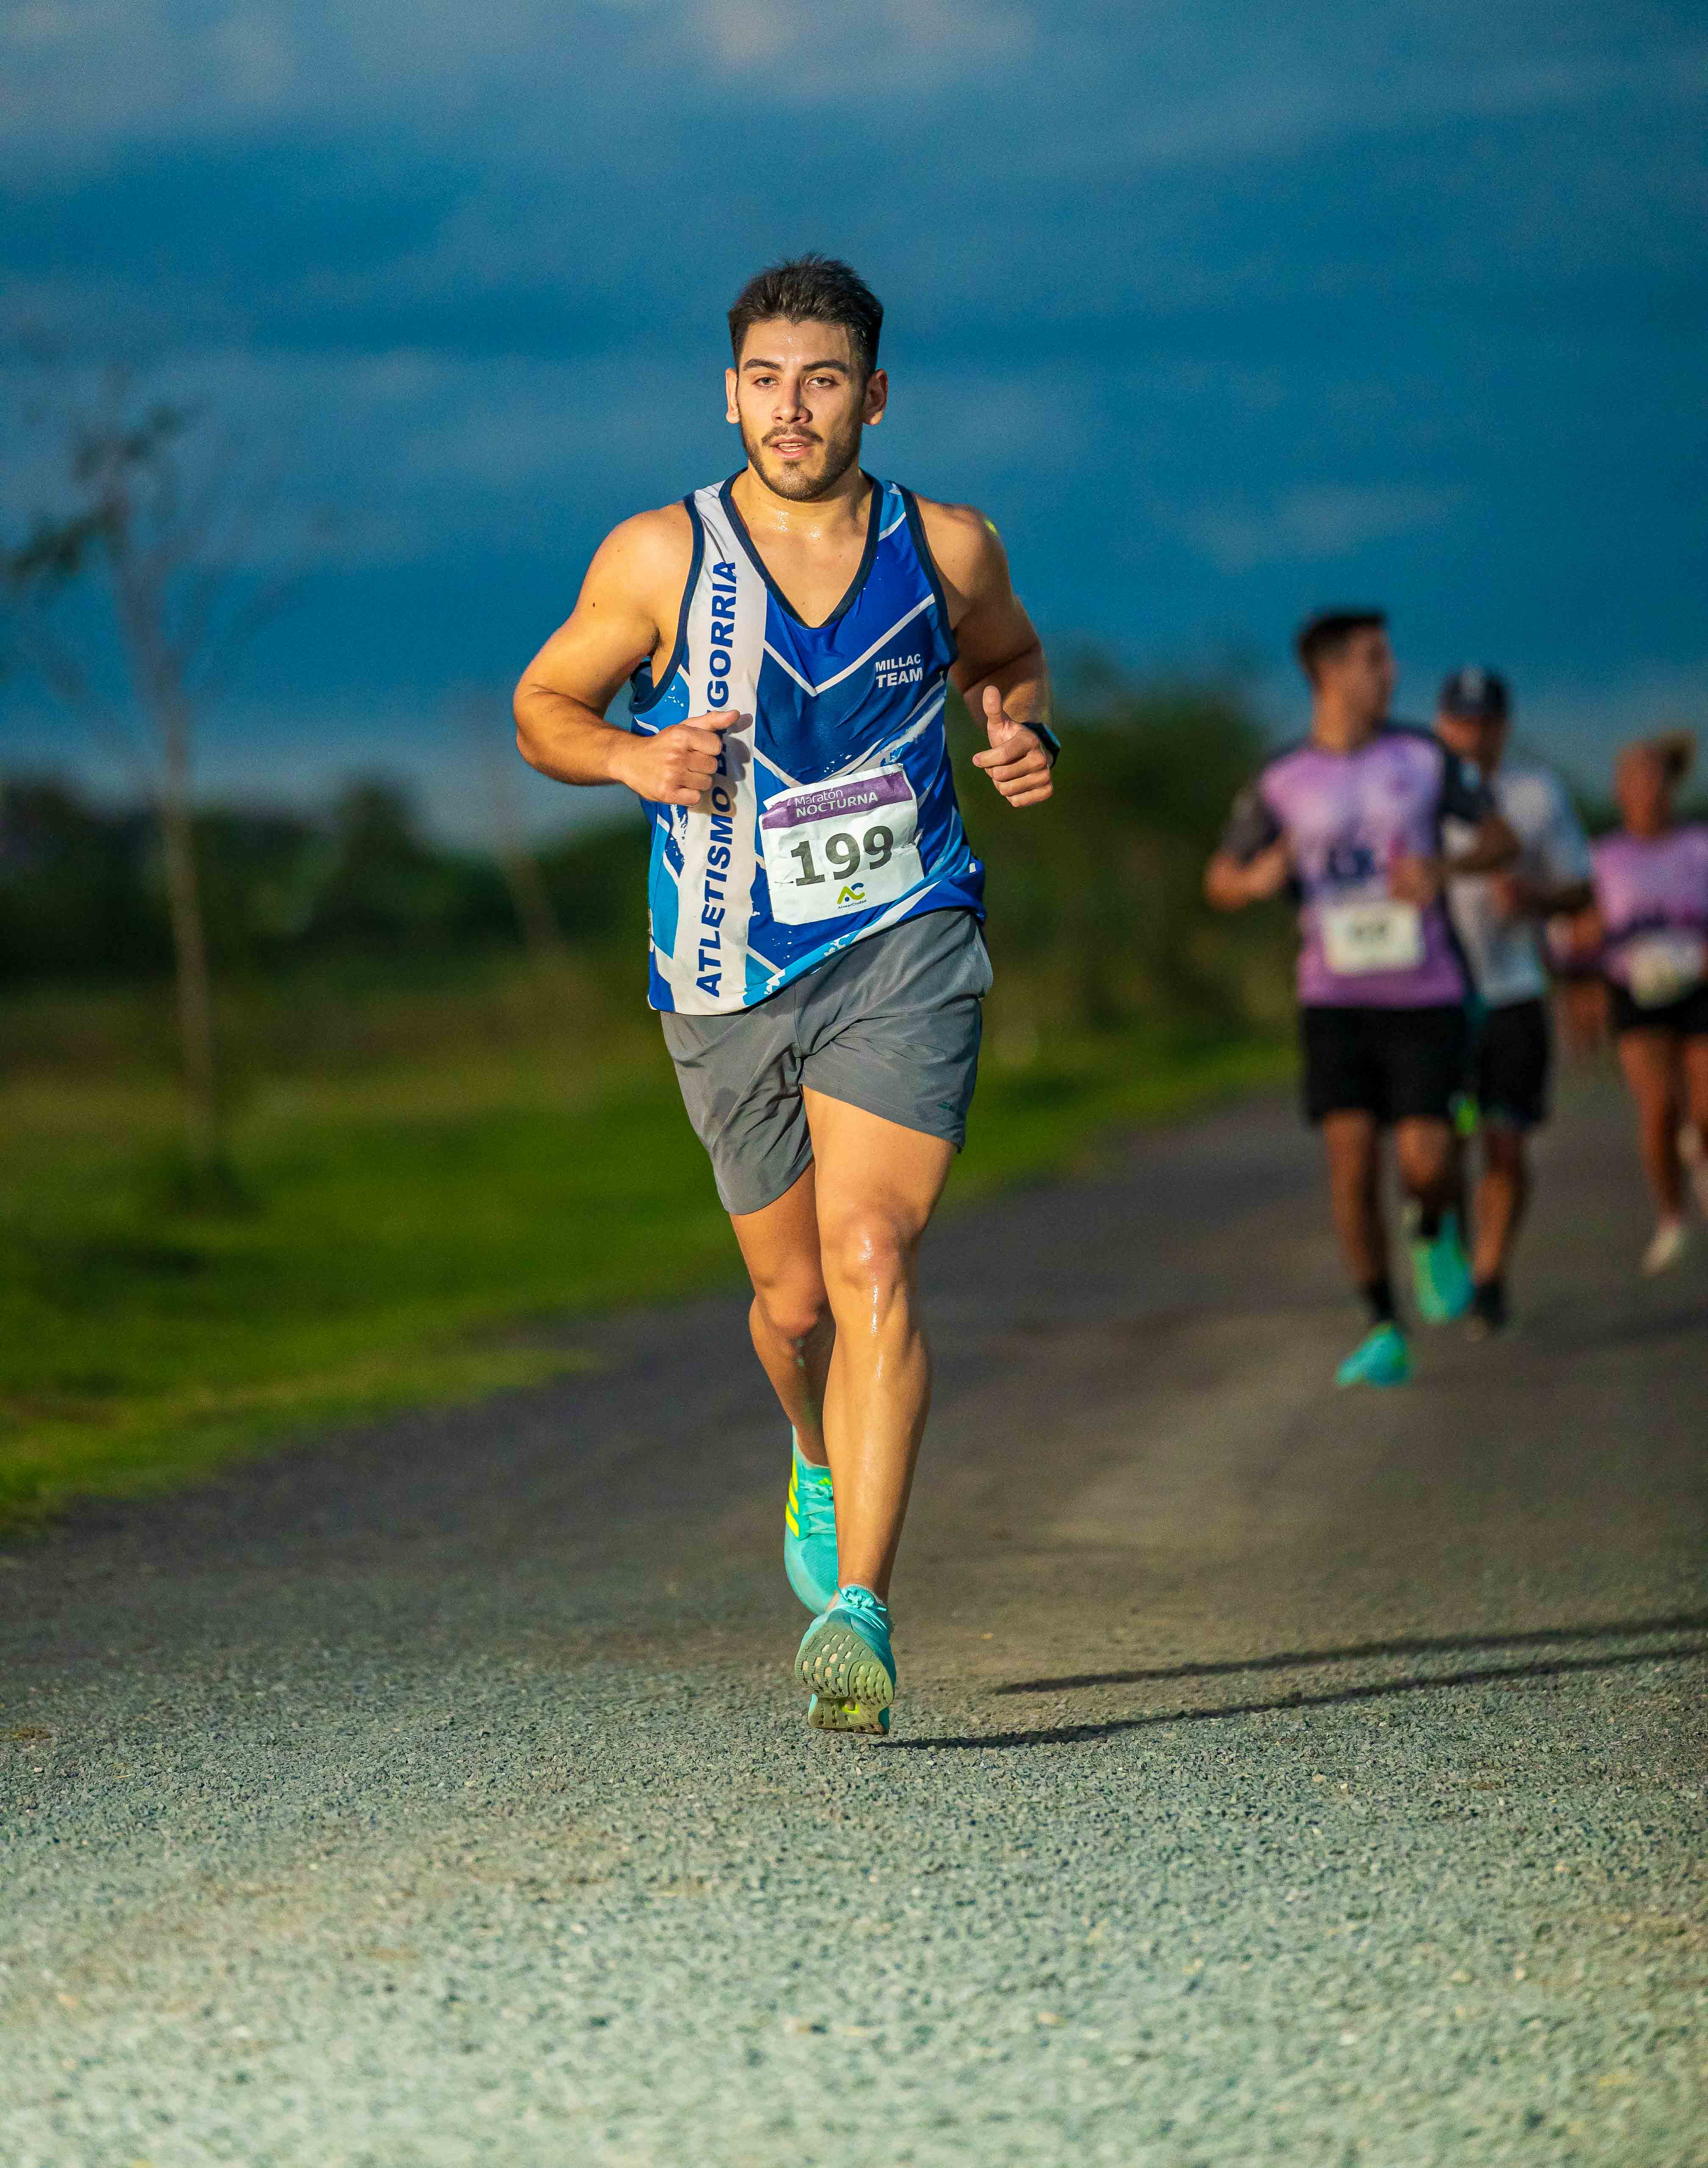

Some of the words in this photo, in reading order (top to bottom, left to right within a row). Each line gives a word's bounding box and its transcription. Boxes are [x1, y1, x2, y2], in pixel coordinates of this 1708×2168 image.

[707, 562, 737, 776] GORRIA
[875, 654, 921, 672] MILLAC
[876, 668, 923, 688] TEAM
[795, 788, 843, 807] Maratón
[796, 791, 878, 818] NOCTURNA
[790, 826, 893, 886] 199
[696, 786, 732, 998] ATLETISMO
[838, 899, 867, 909] AlvearCiudad
